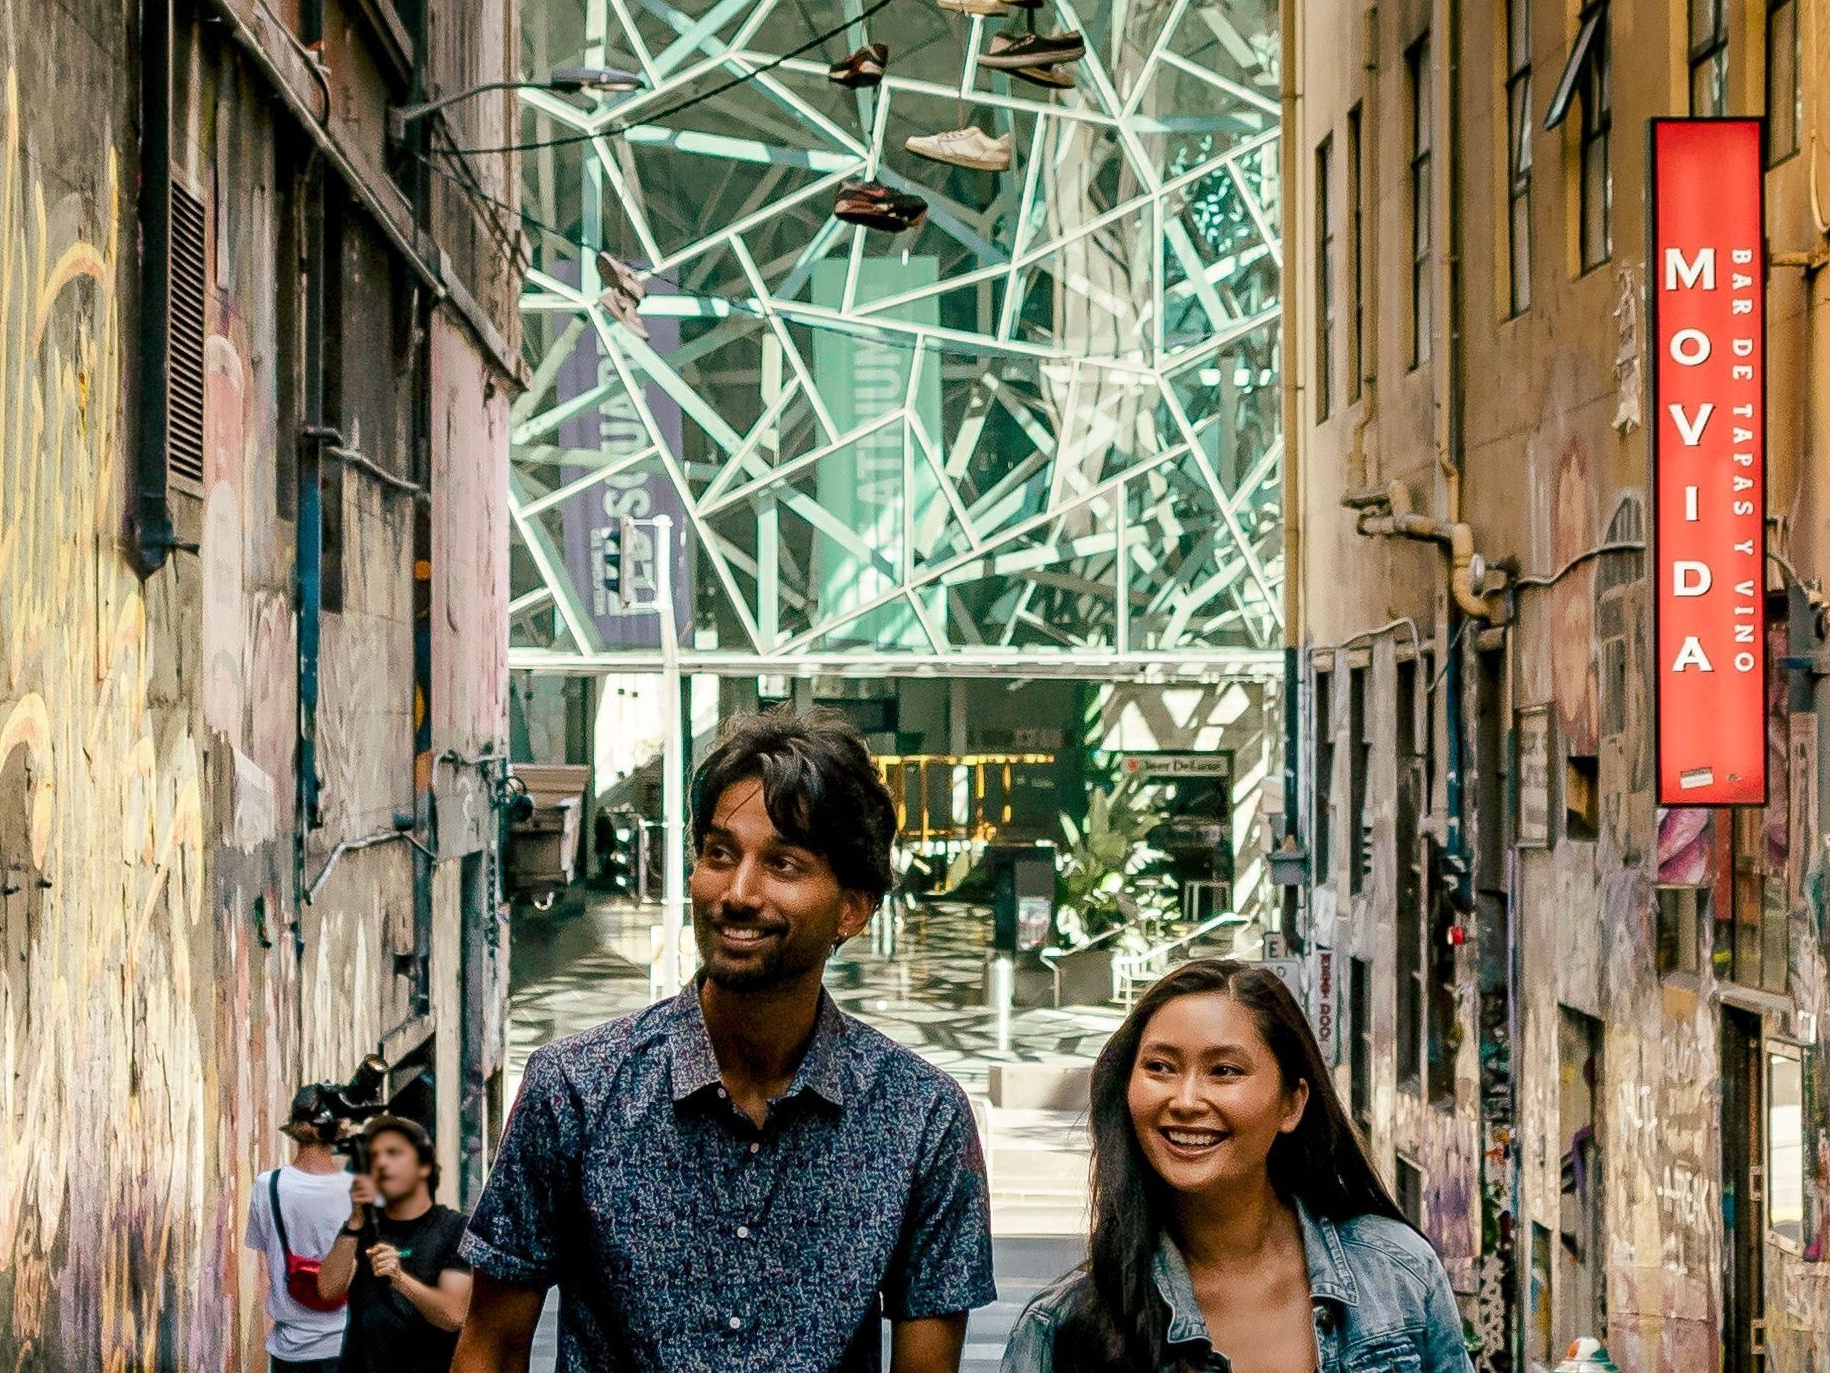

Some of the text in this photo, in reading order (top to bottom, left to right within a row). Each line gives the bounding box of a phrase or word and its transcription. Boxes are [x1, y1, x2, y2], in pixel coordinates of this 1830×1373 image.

[1664, 247, 1717, 673] MOVIDA
[1731, 248, 1755, 672] BAR DE TAPAS Y VINO
